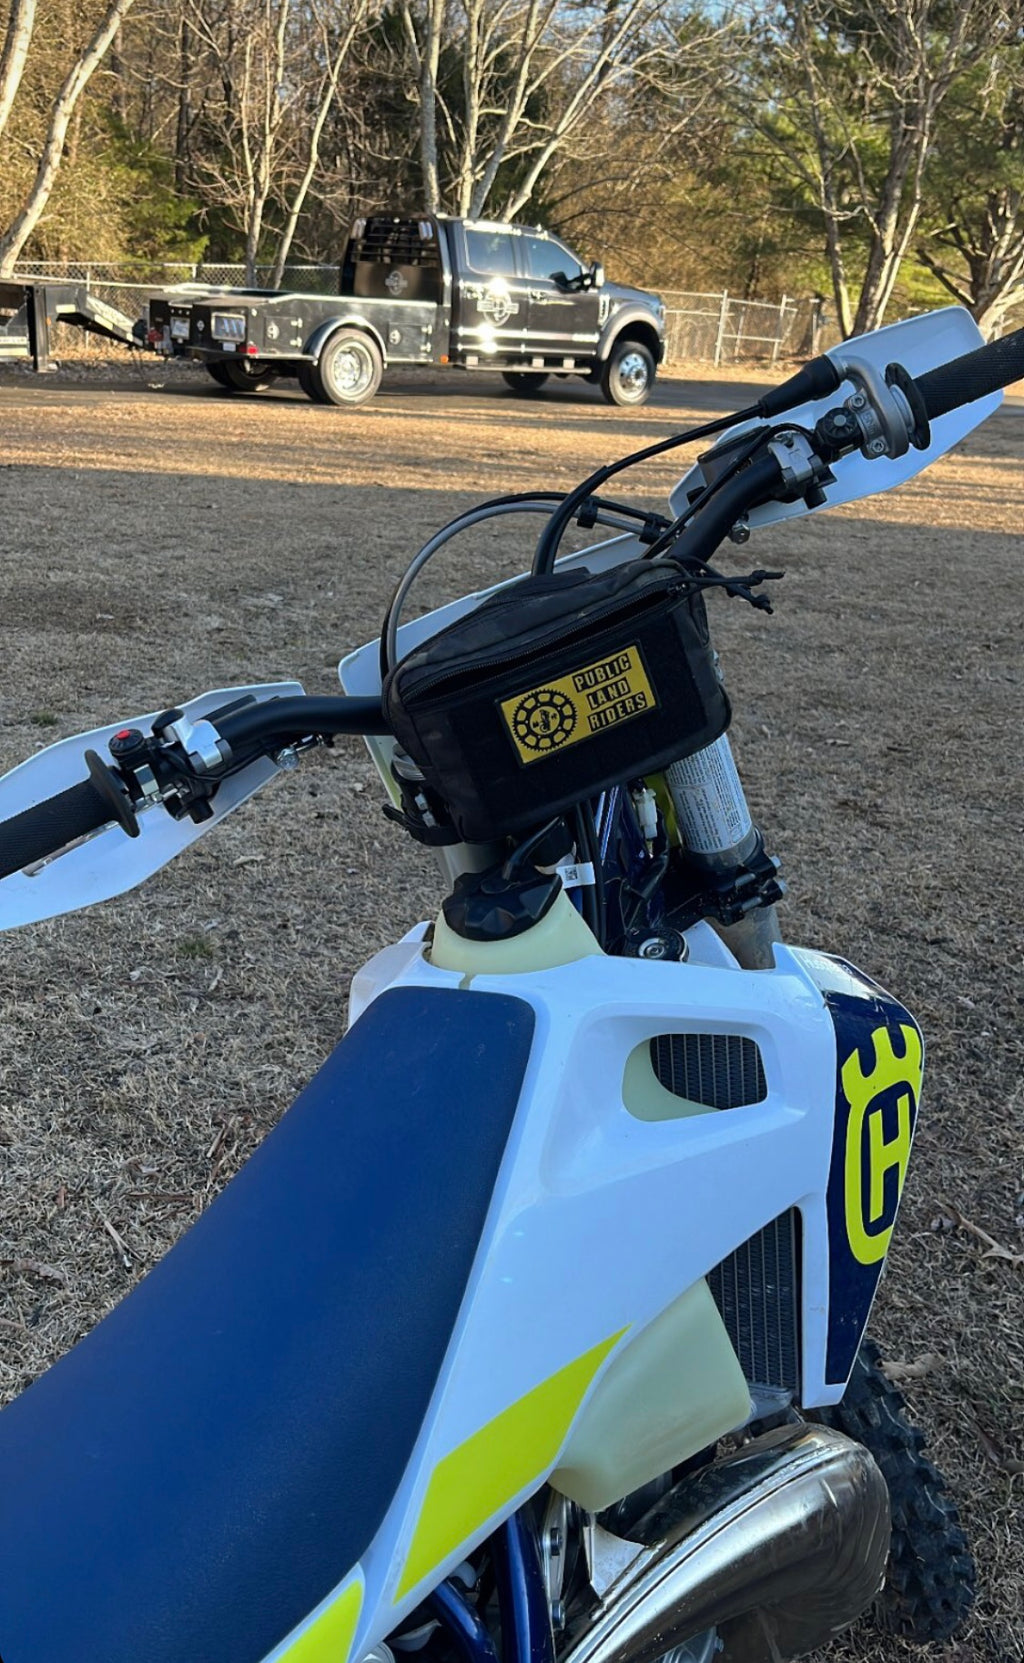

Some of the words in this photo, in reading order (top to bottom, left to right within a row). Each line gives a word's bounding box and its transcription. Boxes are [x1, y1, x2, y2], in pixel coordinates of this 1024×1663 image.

[575, 655, 629, 691] PUBLIC
[588, 680, 628, 708] LAND
[590, 693, 646, 729] RIDERS
